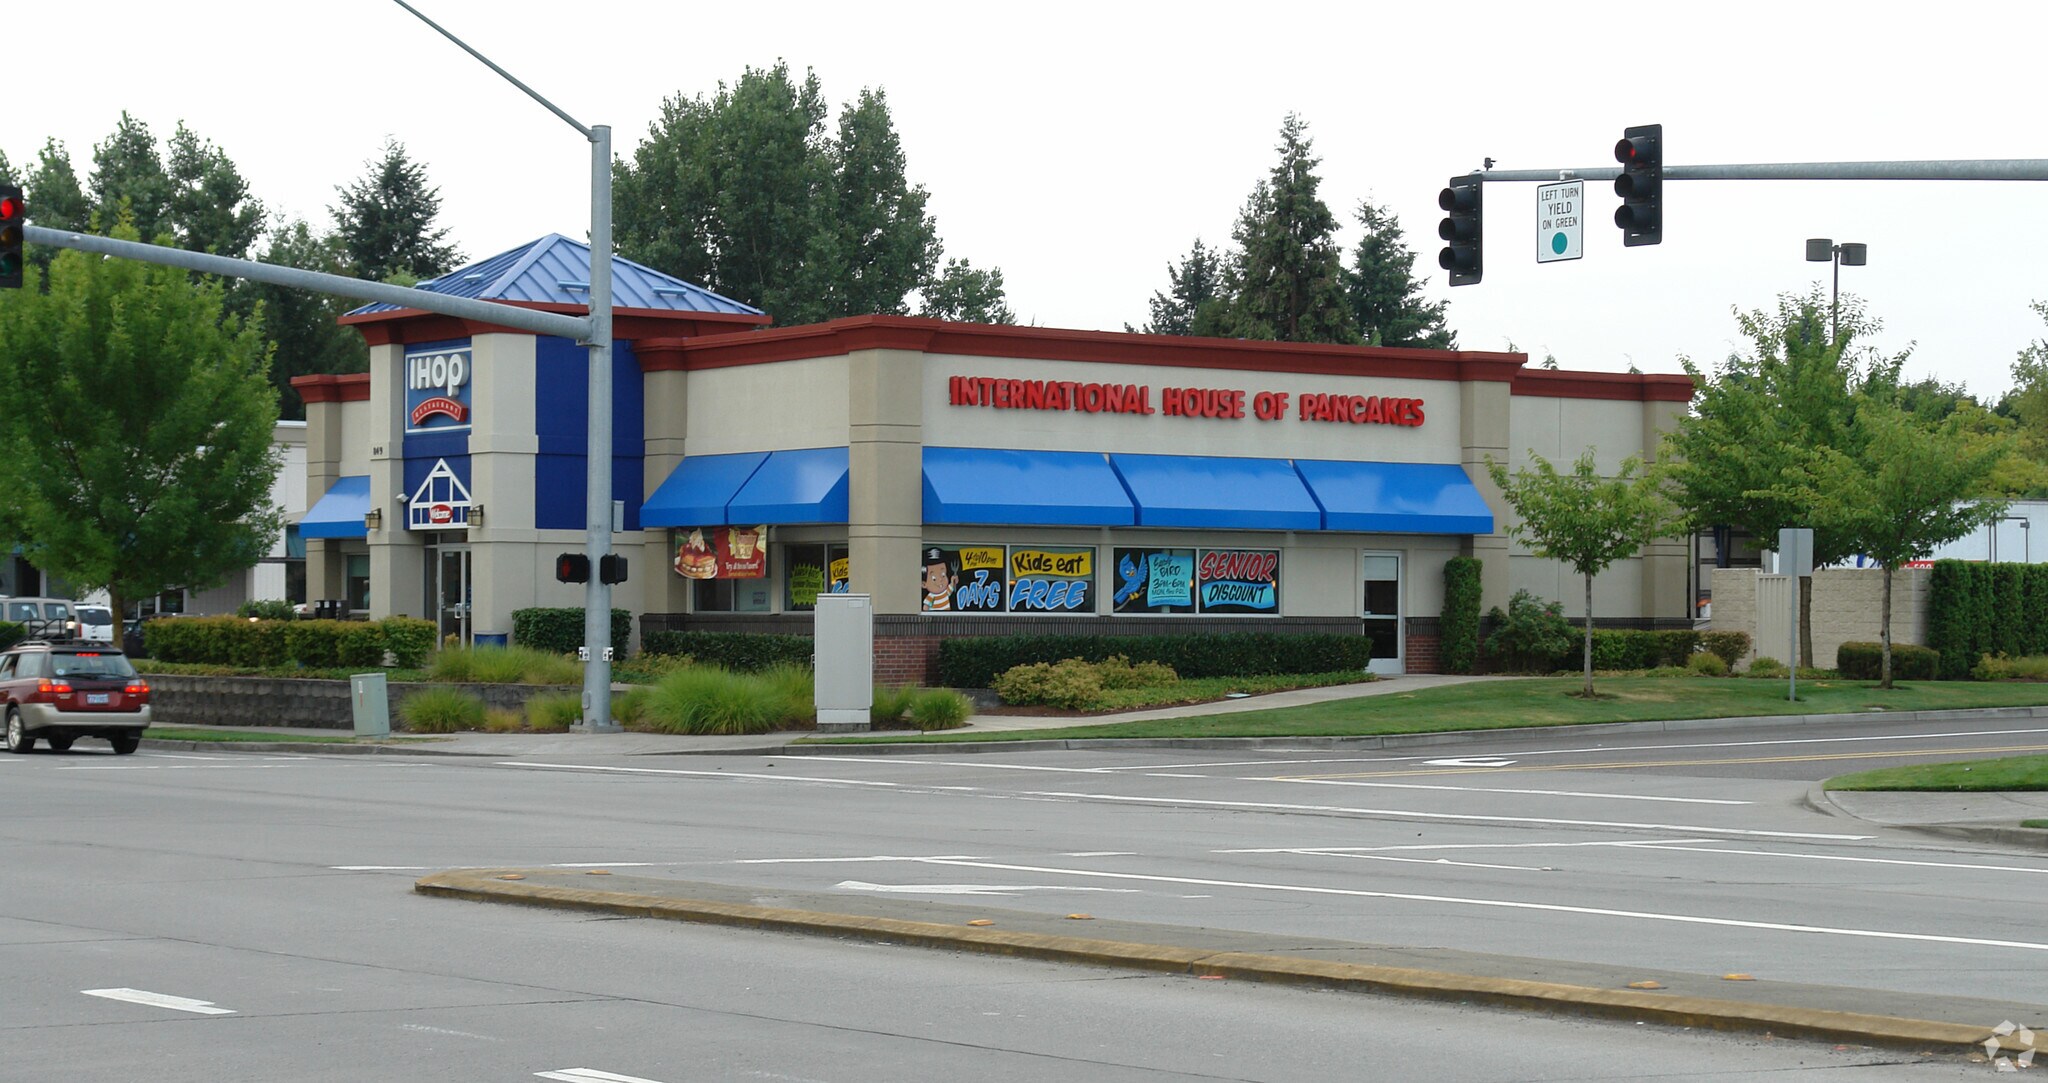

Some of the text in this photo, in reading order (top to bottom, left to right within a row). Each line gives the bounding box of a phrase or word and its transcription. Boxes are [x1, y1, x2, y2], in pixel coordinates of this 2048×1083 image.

[1541, 187, 1579, 201] LEFT TURN
[1548, 201, 1572, 216] YIELD
[1542, 216, 1578, 230] ON GREEN
[414, 401, 459, 418] RESTAURANT
[949, 376, 1425, 428] INTERNATIONAL HOUSE OF PANCAKES
[1014, 553, 1085, 574] Kids eat
[1160, 565, 1181, 578] BIRD
[1199, 551, 1277, 581] SENIOR
[975, 570, 990, 586] 7
[957, 580, 1001, 610] DAYS
[1010, 579, 1087, 610] FREE
[1208, 584, 1268, 604] DISCOUNT
